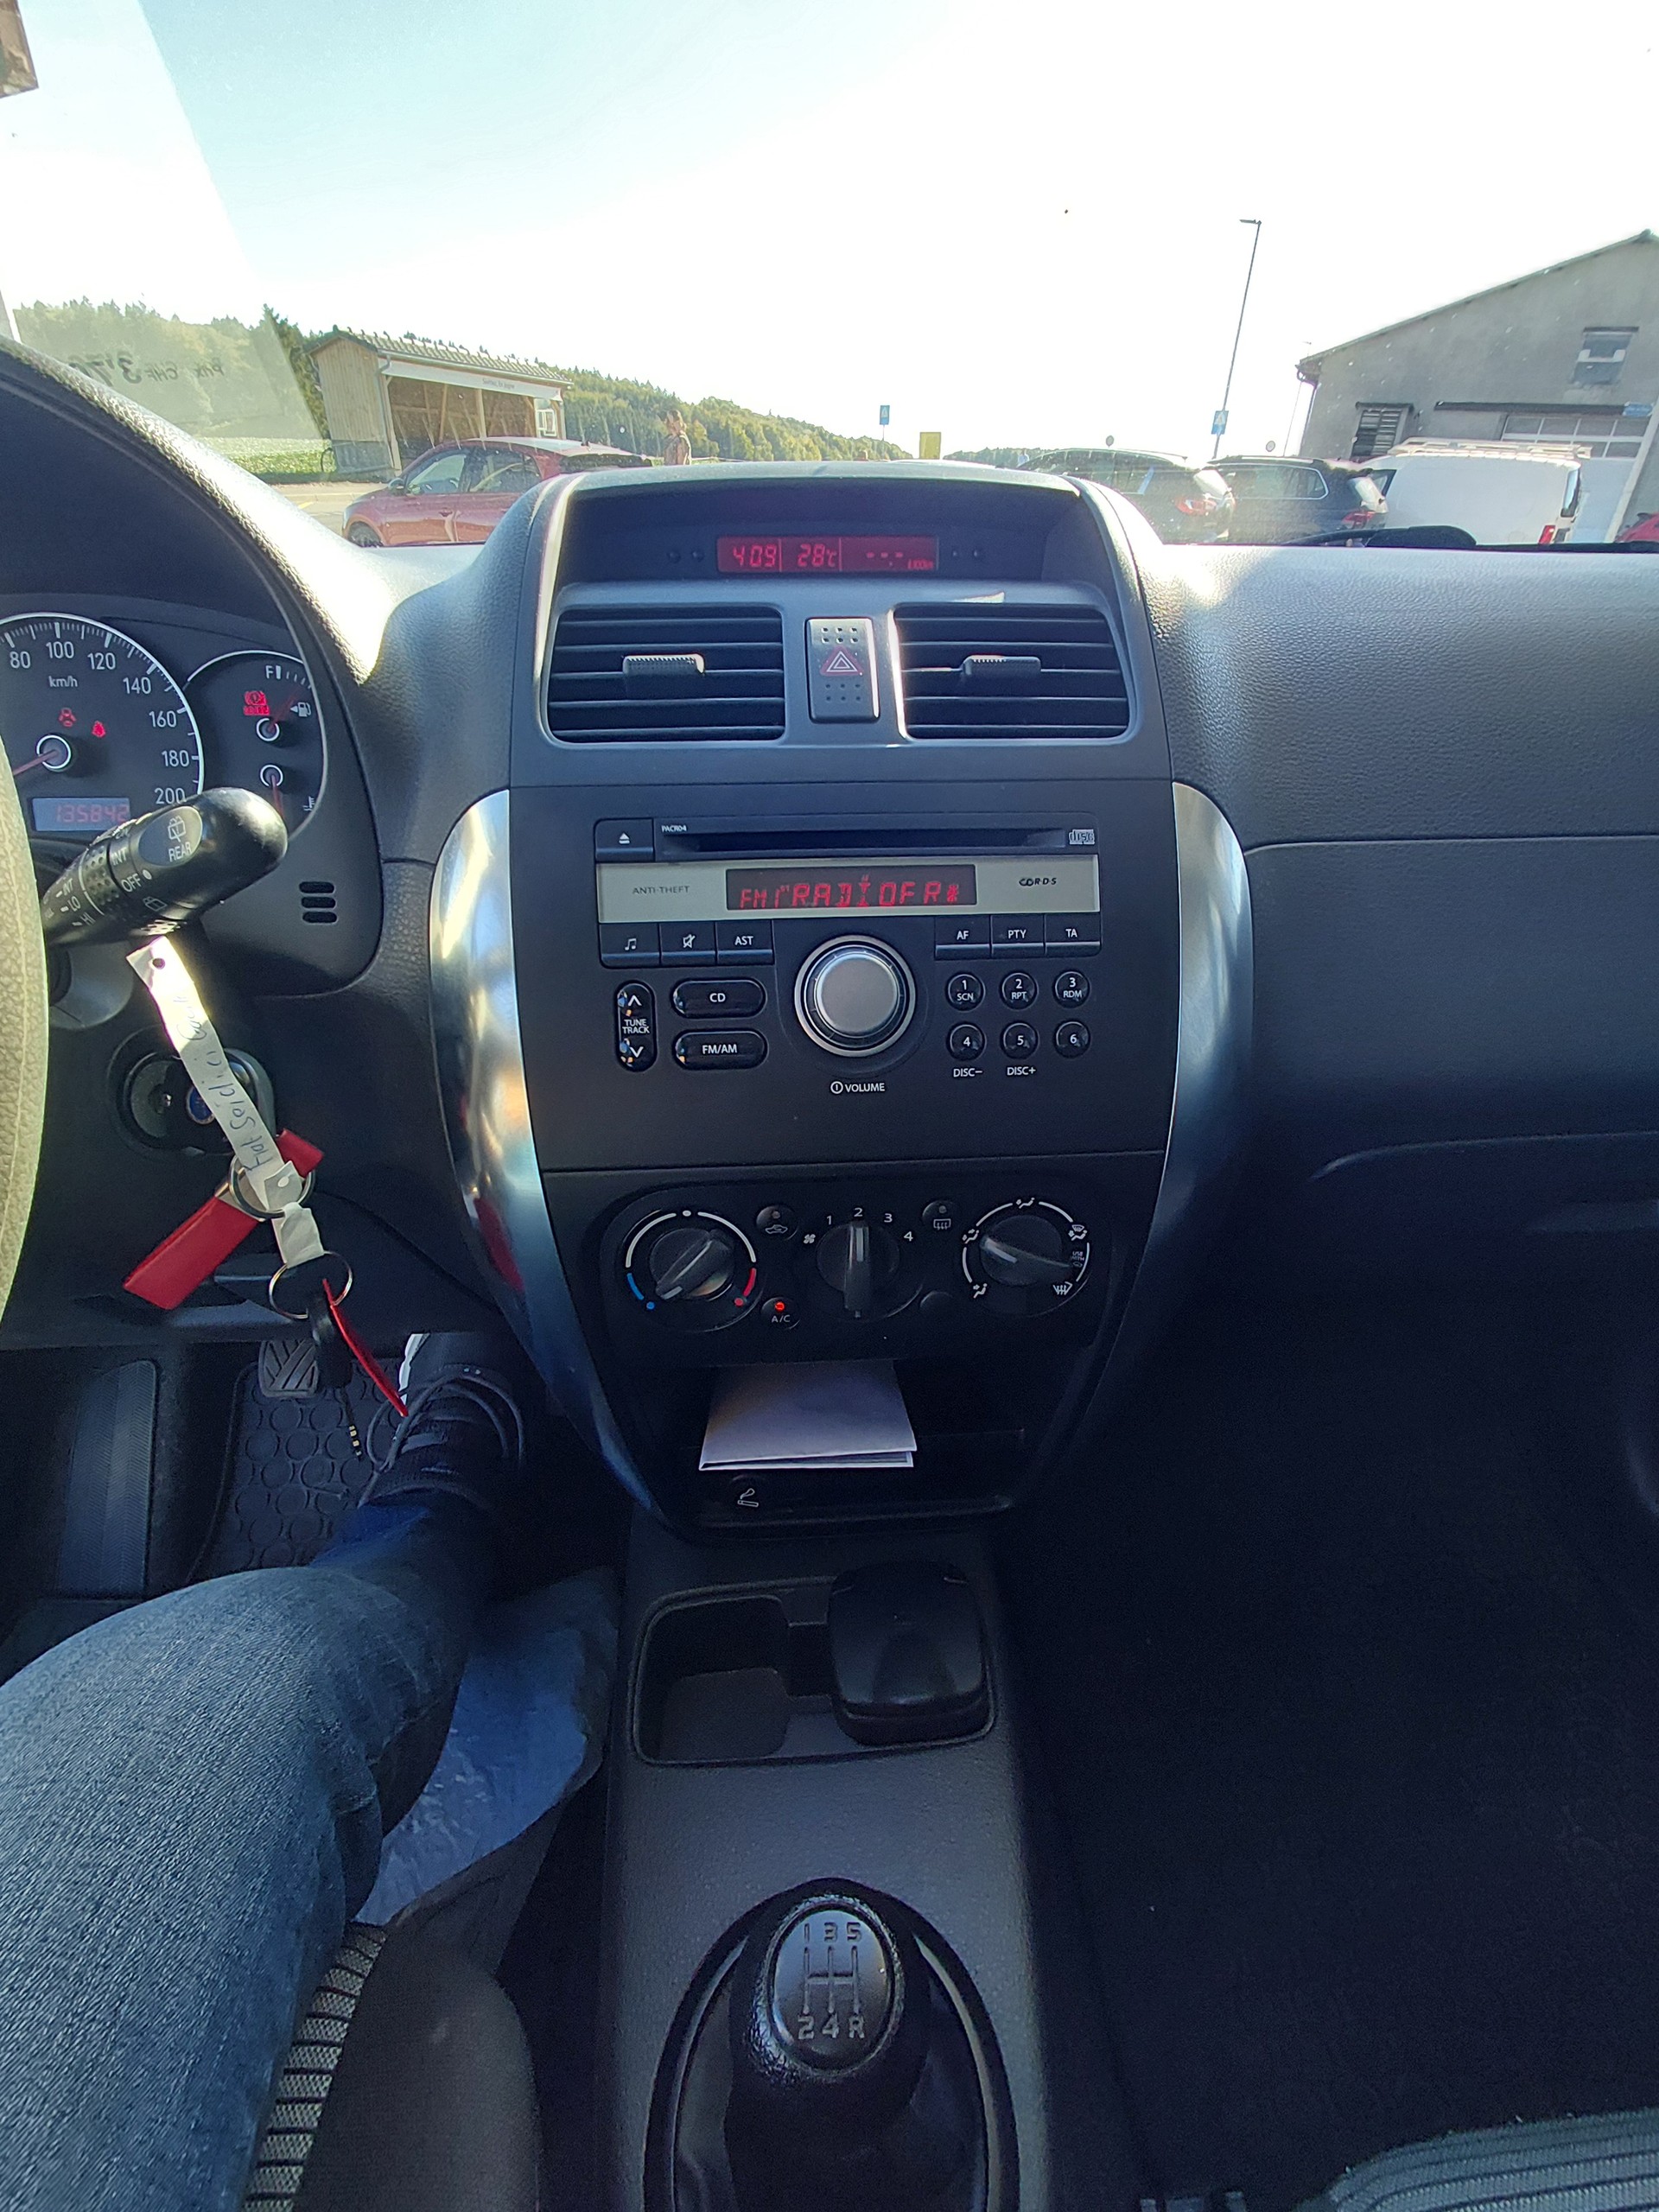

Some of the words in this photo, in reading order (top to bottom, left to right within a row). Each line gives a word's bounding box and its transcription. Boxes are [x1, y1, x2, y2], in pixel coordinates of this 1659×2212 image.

[46, 641, 74, 659] 100
[10, 651, 31, 670] 80
[87, 652, 116, 671] 120
[265, 665, 275, 679] F
[48, 675, 78, 688] km/h
[123, 677, 151, 695] 140
[149, 710, 177, 728] 160
[162, 749, 189, 767] 180
[154, 787, 186, 805] 200
[111, 847, 128, 866] INT
[168, 842, 192, 862] REAR
[121, 873, 143, 893] OFF
[632, 885, 690, 894] ANTI-THEFT
[67, 897, 81, 912] LO
[80, 912, 97, 926] HI
[957, 929, 969, 940] AF
[1008, 929, 1027, 939] PTY
[1065, 928, 1077, 938] TA
[734, 936, 753, 945] AST
[962, 980, 968, 990] 1
[1015, 979, 1023, 989] 2
[1069, 977, 1077, 988] 3
[709, 993, 726, 1003] CD
[957, 993, 974, 1001] SCN
[1011, 992, 1027, 1001] RPT
[624, 1019, 647, 1027] TUNE
[622, 1026, 650, 1034] TRACK
[963, 1037, 971, 1047] 4
[1017, 1035, 1024, 1046] 5
[1070, 1033, 1077, 1044] 6
[702, 1044, 738, 1055] FM/AM
[845, 1083, 885, 1092] VOLUME
[854, 1207, 863, 1217] 2
[826, 1215, 832, 1225] 1
[884, 1213, 893, 1223] 3
[903, 1230, 913, 1242] 4
[772, 1314, 791, 1323] A/C
[804, 1923, 810, 1942] 1
[824, 1923, 838, 1942] 3
[847, 1922, 861, 1942] 5
[798, 2016, 814, 2039] 2
[823, 2013, 839, 2038] 4
[849, 2016, 865, 2039] R
